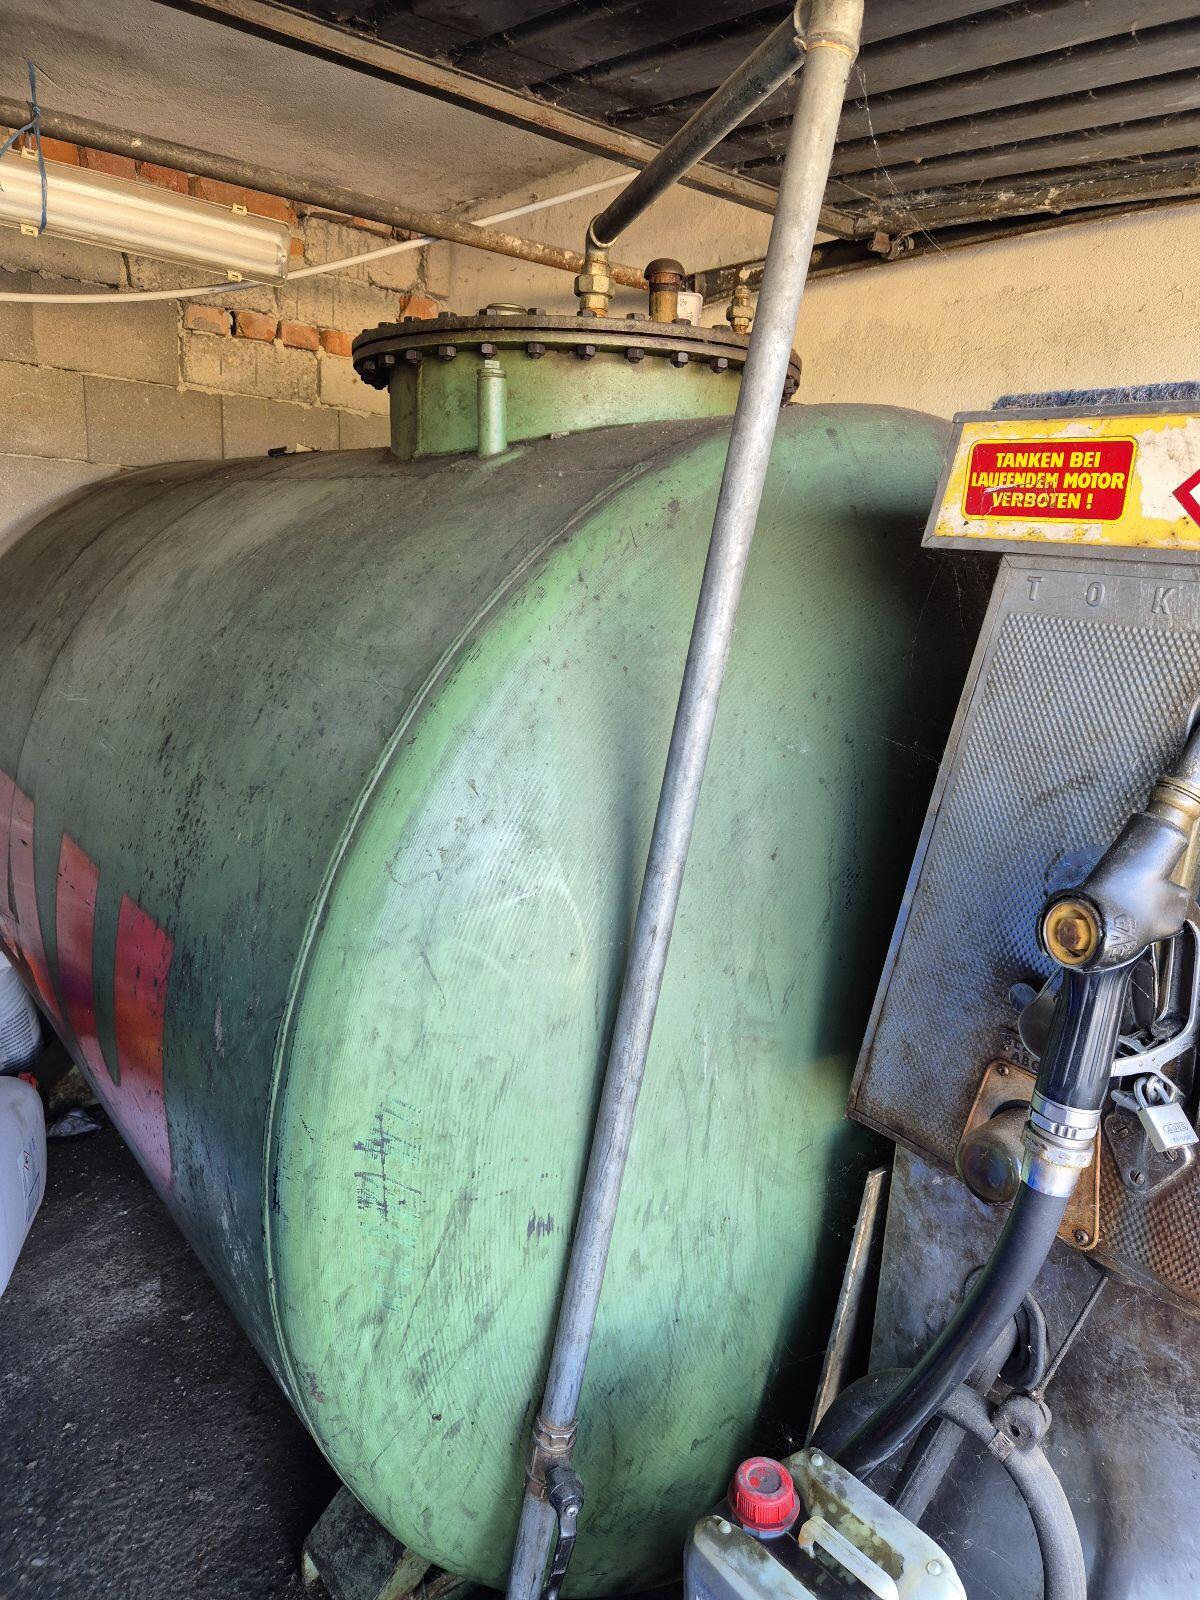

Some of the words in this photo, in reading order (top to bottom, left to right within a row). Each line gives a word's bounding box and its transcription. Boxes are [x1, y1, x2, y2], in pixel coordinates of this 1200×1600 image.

[996, 452, 1065, 468] TANKEN
[1069, 451, 1102, 468] BEI
[971, 472, 1059, 489] LAUFENDEM
[1063, 472, 1126, 490] MOTOR
[992, 492, 1082, 509] VERBOTEN
